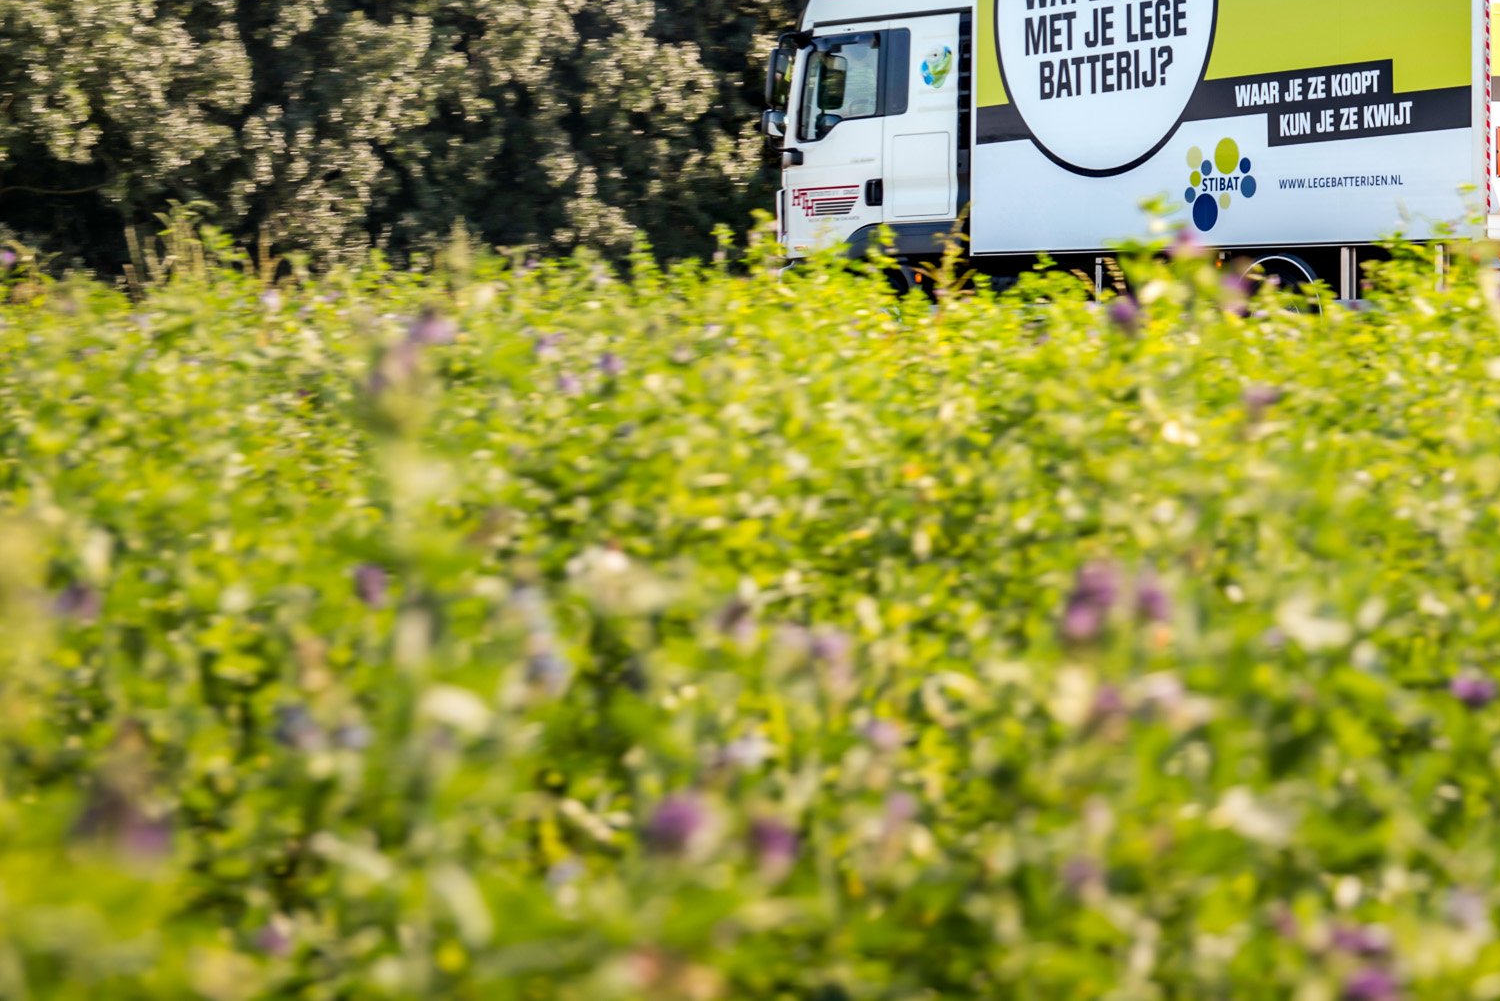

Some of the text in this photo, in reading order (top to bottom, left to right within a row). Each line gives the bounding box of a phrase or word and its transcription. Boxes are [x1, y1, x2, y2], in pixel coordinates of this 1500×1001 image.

[1025, 11, 1076, 56] MET
[1084, 6, 1114, 48] JE
[1040, 45, 1173, 100] BATTERIJ?
[1235, 69, 1380, 107] WAAR JE ZE KOOPT
[1279, 101, 1413, 137] KUN JE ZE KWIJT
[1202, 176, 1240, 192] STIBAT
[1279, 174, 1403, 189] WWW.LEGEBATTERIJEN.NL
